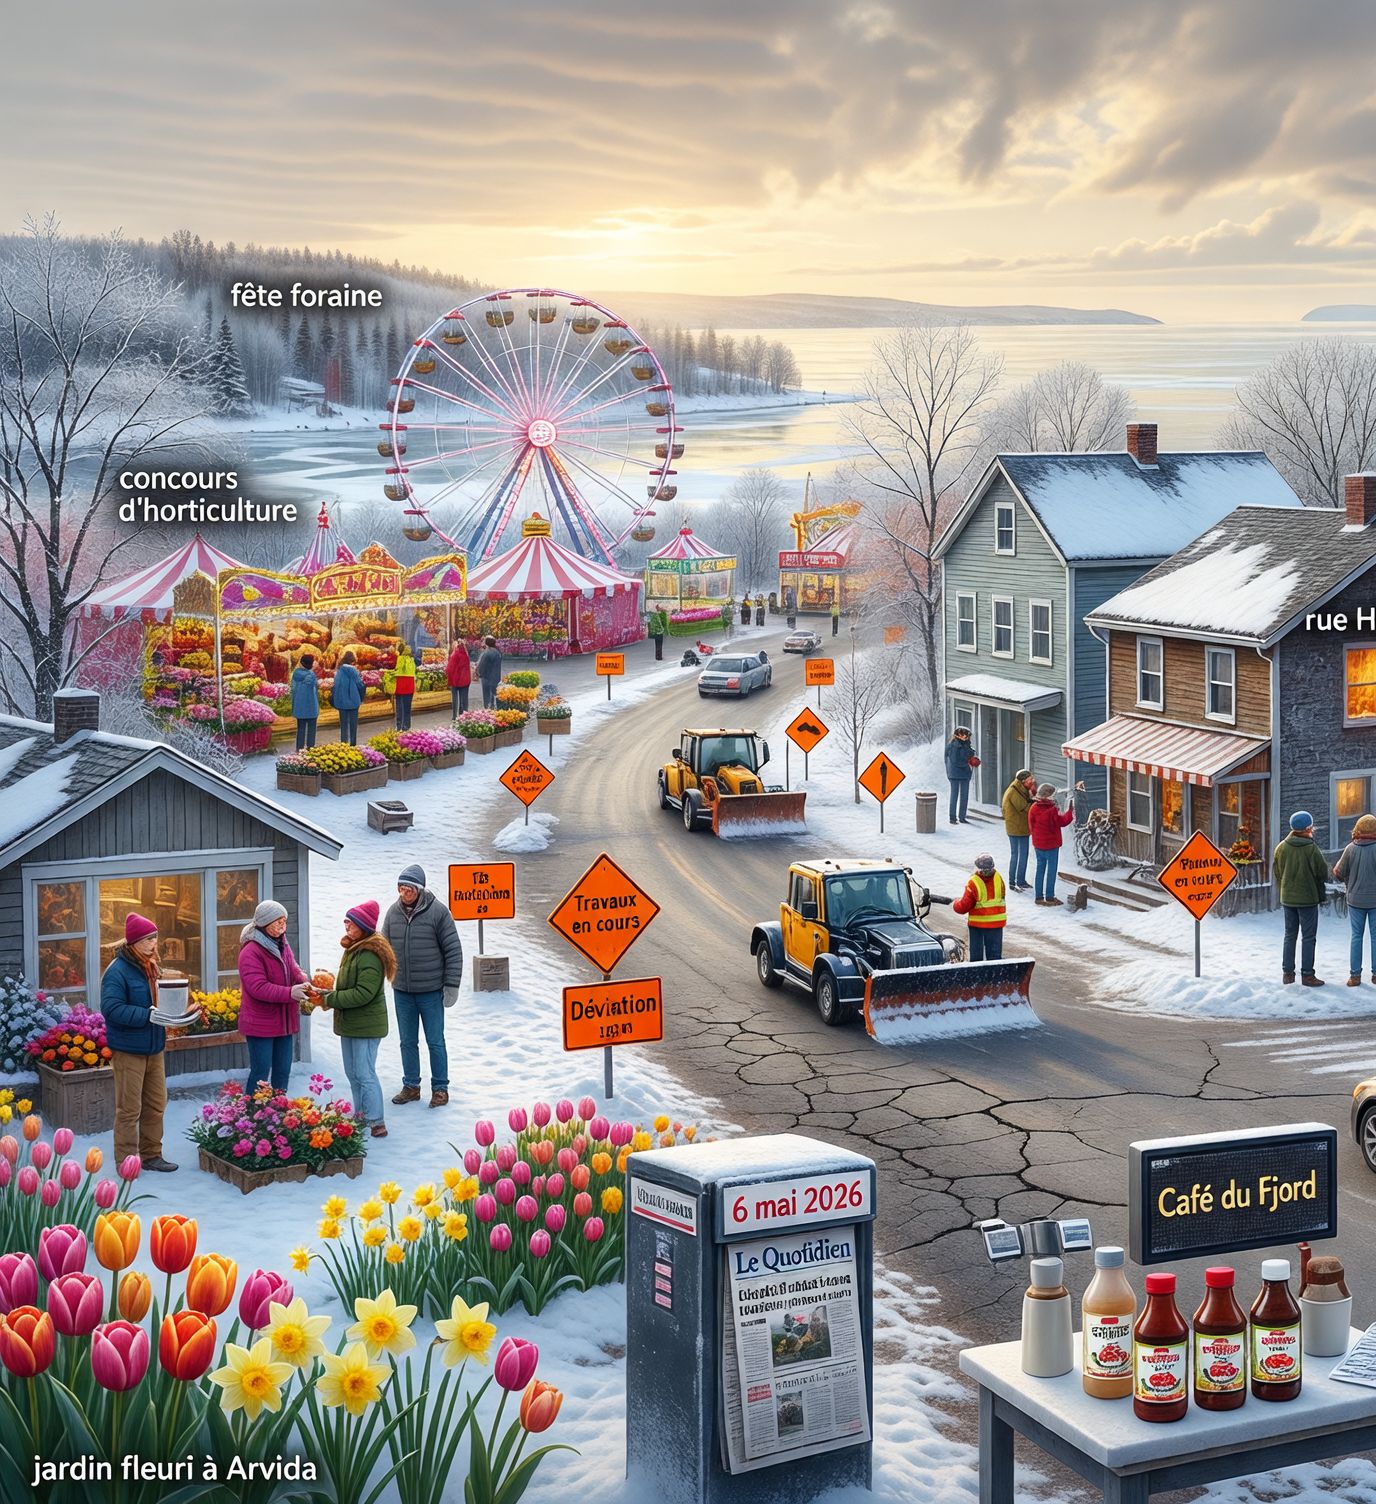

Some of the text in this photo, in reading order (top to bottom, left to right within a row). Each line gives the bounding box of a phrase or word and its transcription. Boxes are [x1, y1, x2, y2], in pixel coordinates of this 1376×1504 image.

[574, 894, 637, 912] Travaux
[572, 915, 640, 934] en cours
[571, 994, 657, 1021] Déviation
[732, 1180, 863, 1223] 6 mai 2026
[1157, 1169, 1317, 1217] Café du Fjord
[735, 1238, 852, 1275] Le Quotidien
